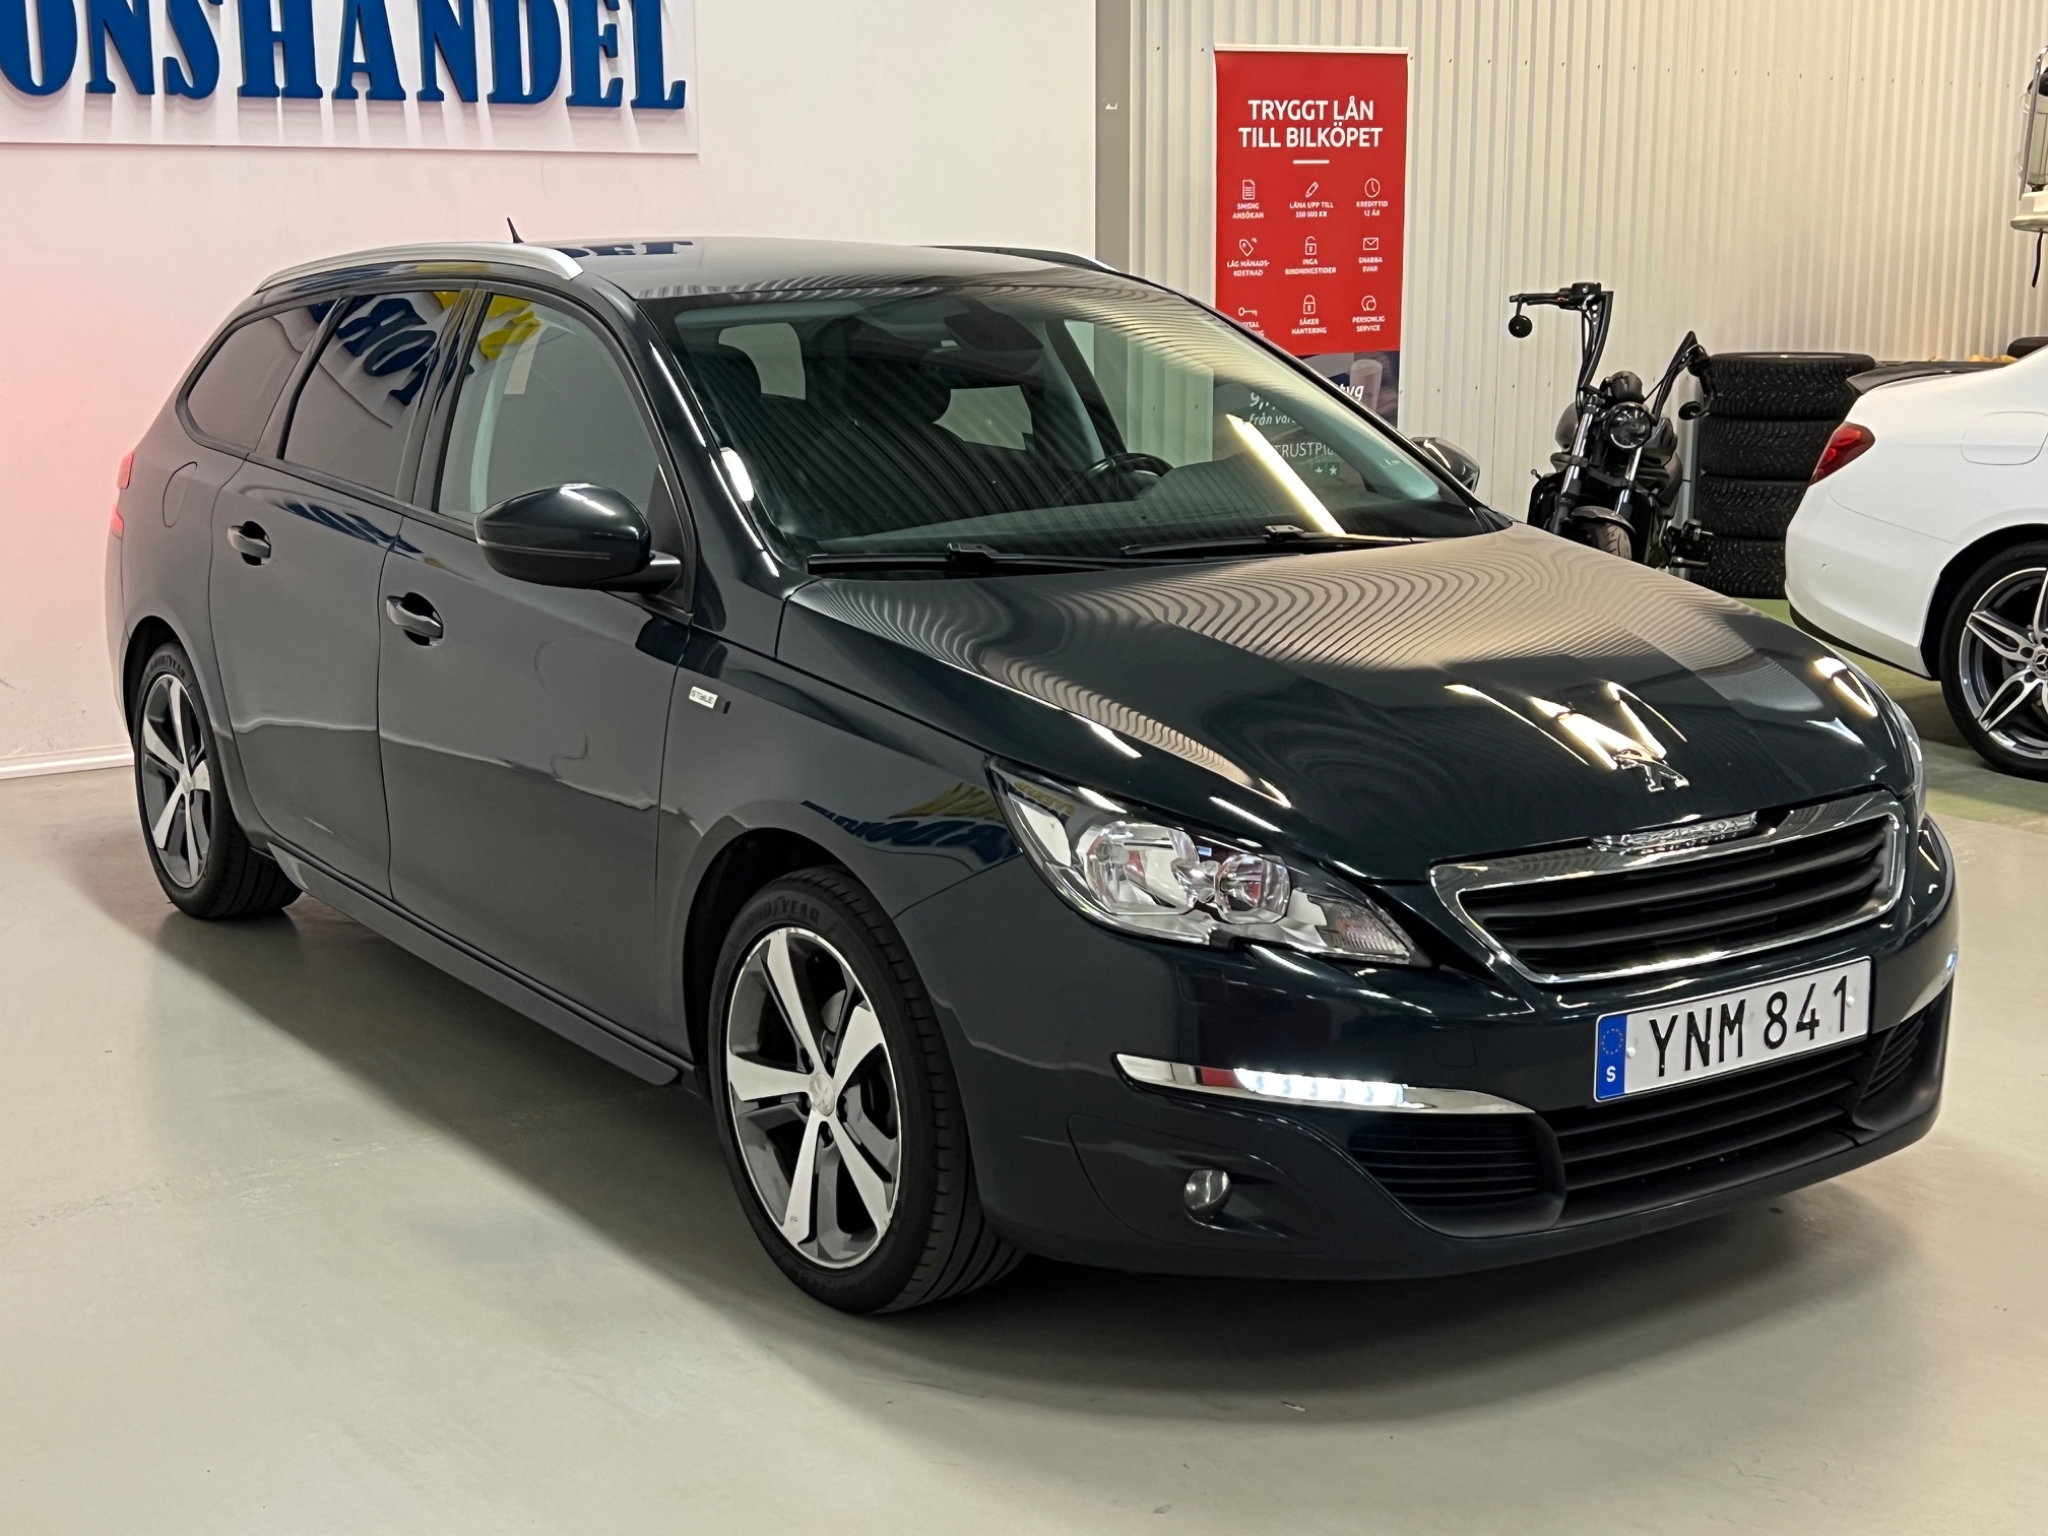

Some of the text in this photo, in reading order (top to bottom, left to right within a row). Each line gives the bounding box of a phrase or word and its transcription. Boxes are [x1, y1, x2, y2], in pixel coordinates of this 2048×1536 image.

[1248, 95, 1374, 121] TRYGGT LÅN
[1238, 121, 1384, 148] TILL BILKÖPET
[1232, 210, 1264, 219] ANSÖKAN
[1299, 318, 1320, 326] SÄKER
[1352, 315, 1386, 324] PERSONLIG
[1356, 324, 1381, 332] SERVICE
[1649, 975, 1849, 1078] YNM 841
[1605, 1065, 1617, 1083] S
